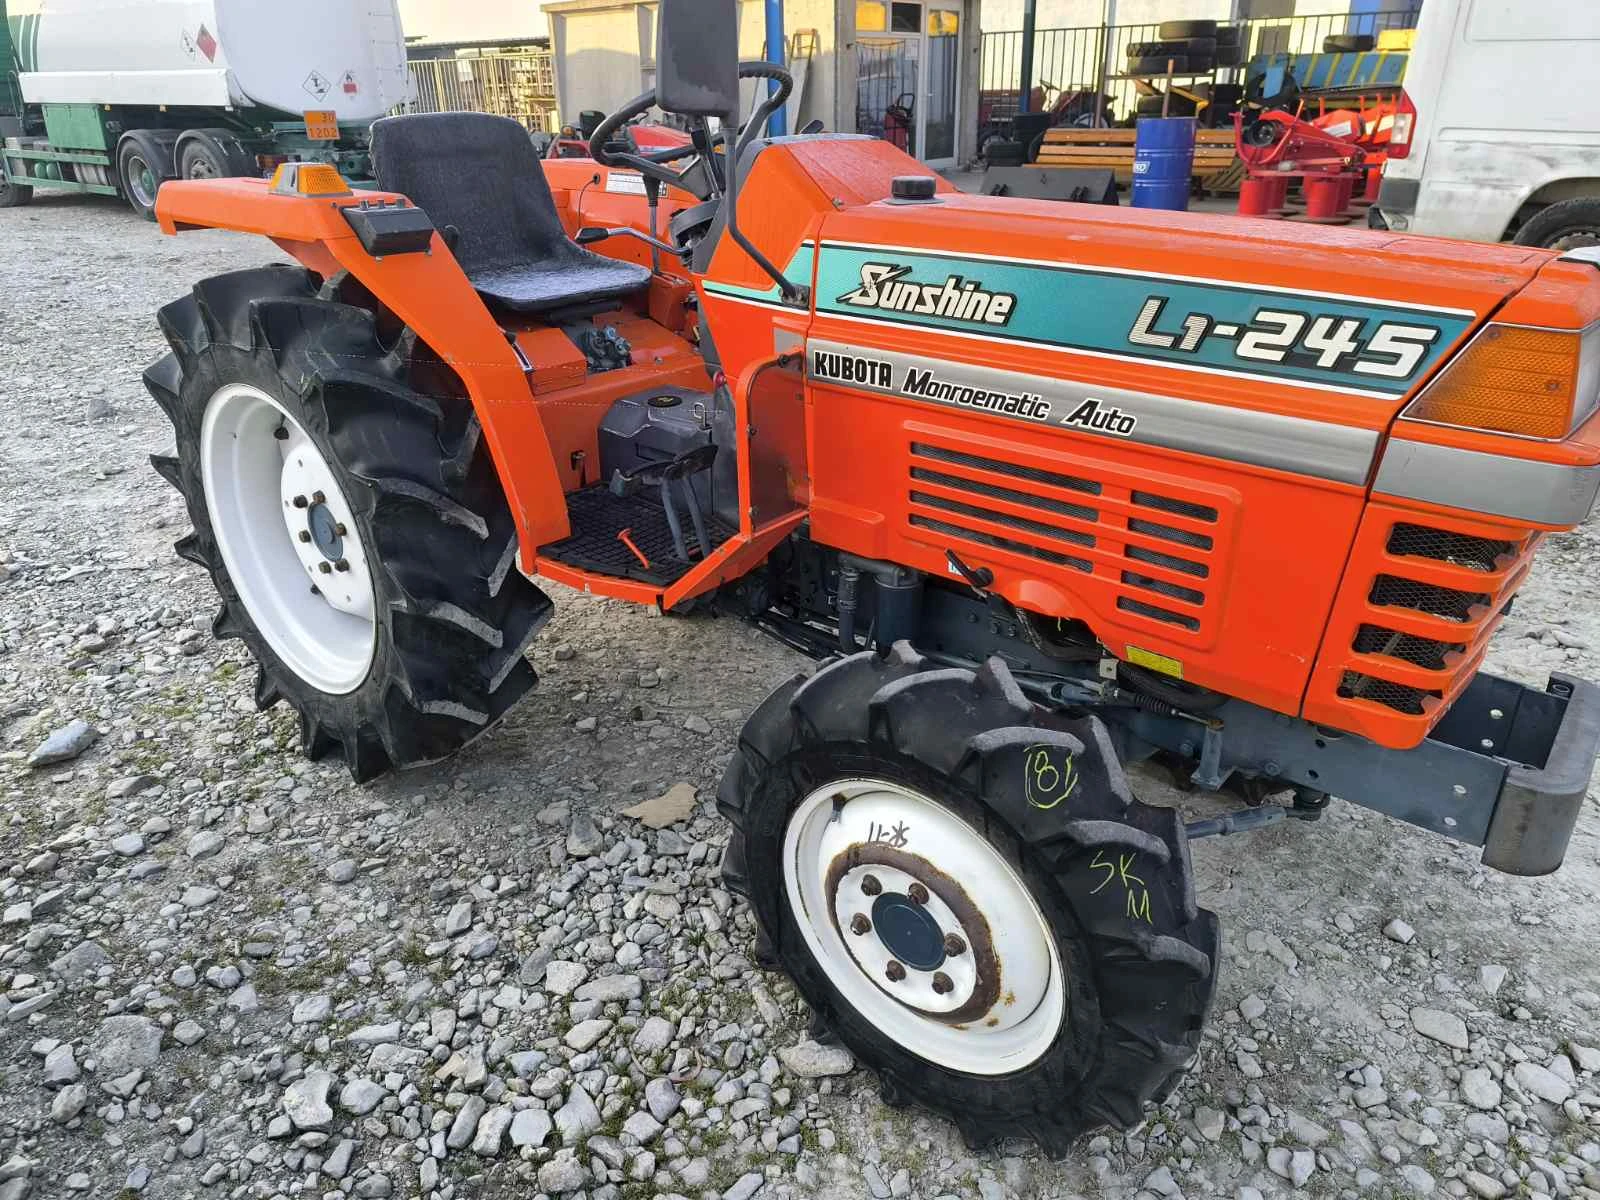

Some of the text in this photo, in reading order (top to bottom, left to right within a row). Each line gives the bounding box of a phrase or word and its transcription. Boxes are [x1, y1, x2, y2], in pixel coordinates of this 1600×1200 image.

[309, 127, 337, 138] 1202
[837, 262, 1017, 327] Sunshine
[1128, 297, 1440, 378] L1-245
[814, 351, 1136, 436] KUBOTA Monroematic Auto
